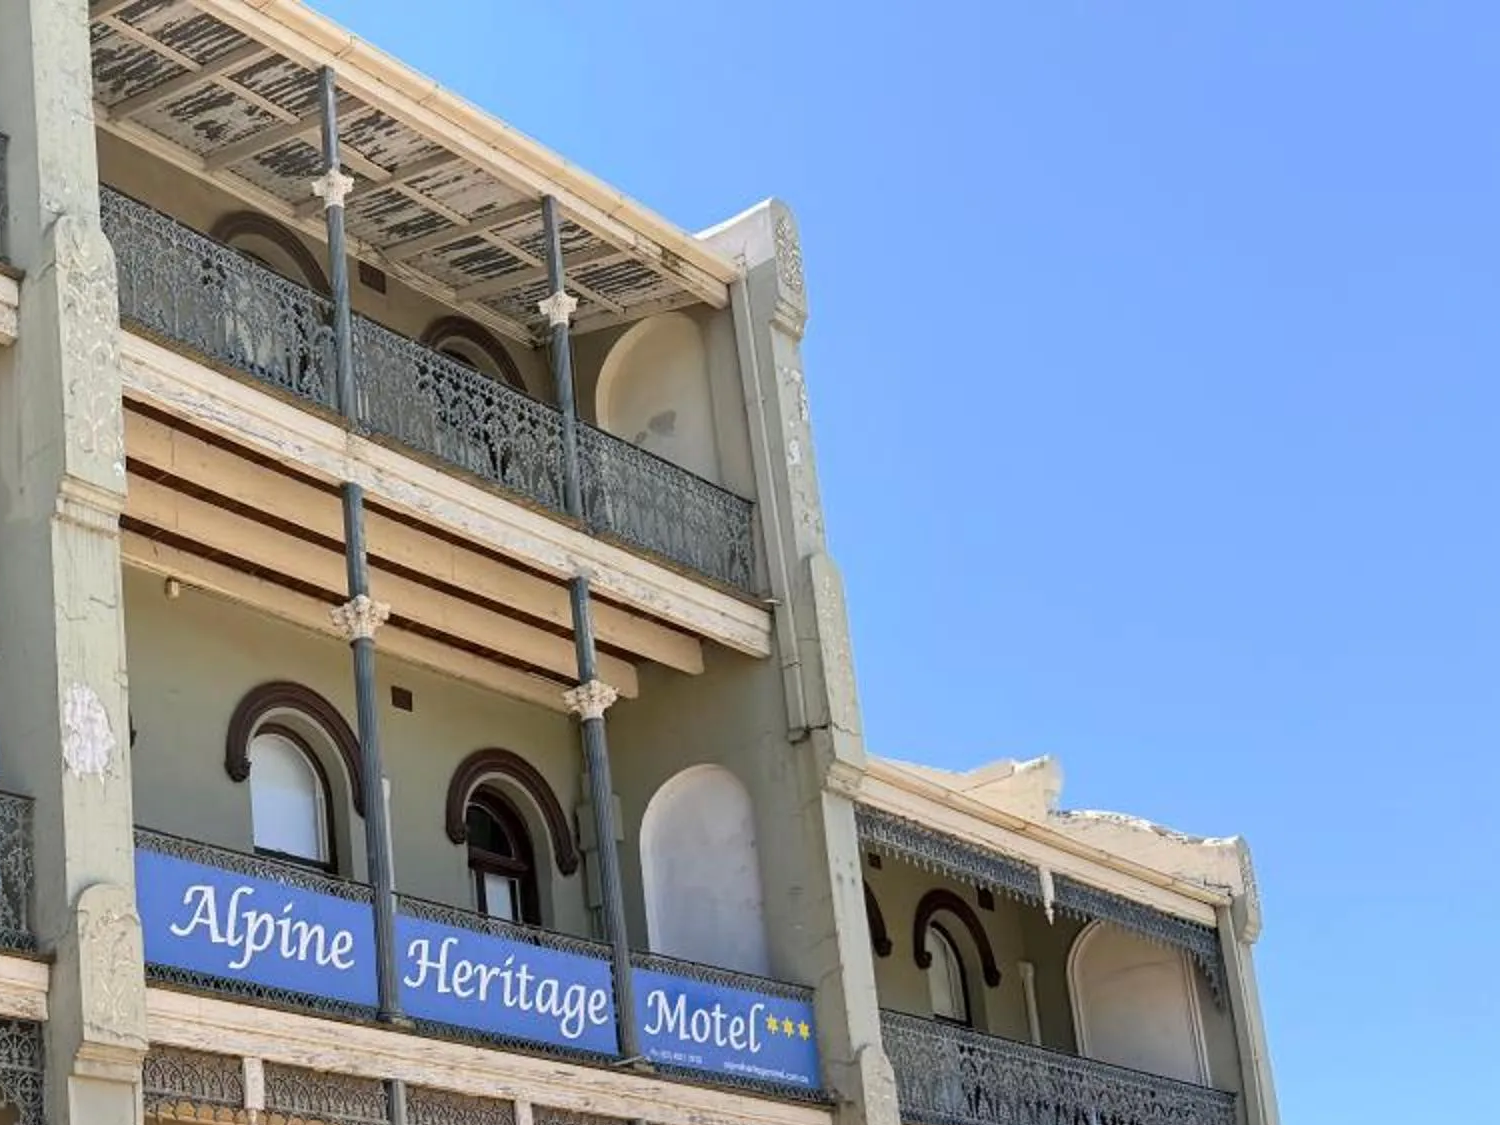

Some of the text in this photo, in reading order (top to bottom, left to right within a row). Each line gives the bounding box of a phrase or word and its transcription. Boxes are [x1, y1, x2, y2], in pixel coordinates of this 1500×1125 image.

[170, 884, 765, 1053] Alpine Heritage Motel
